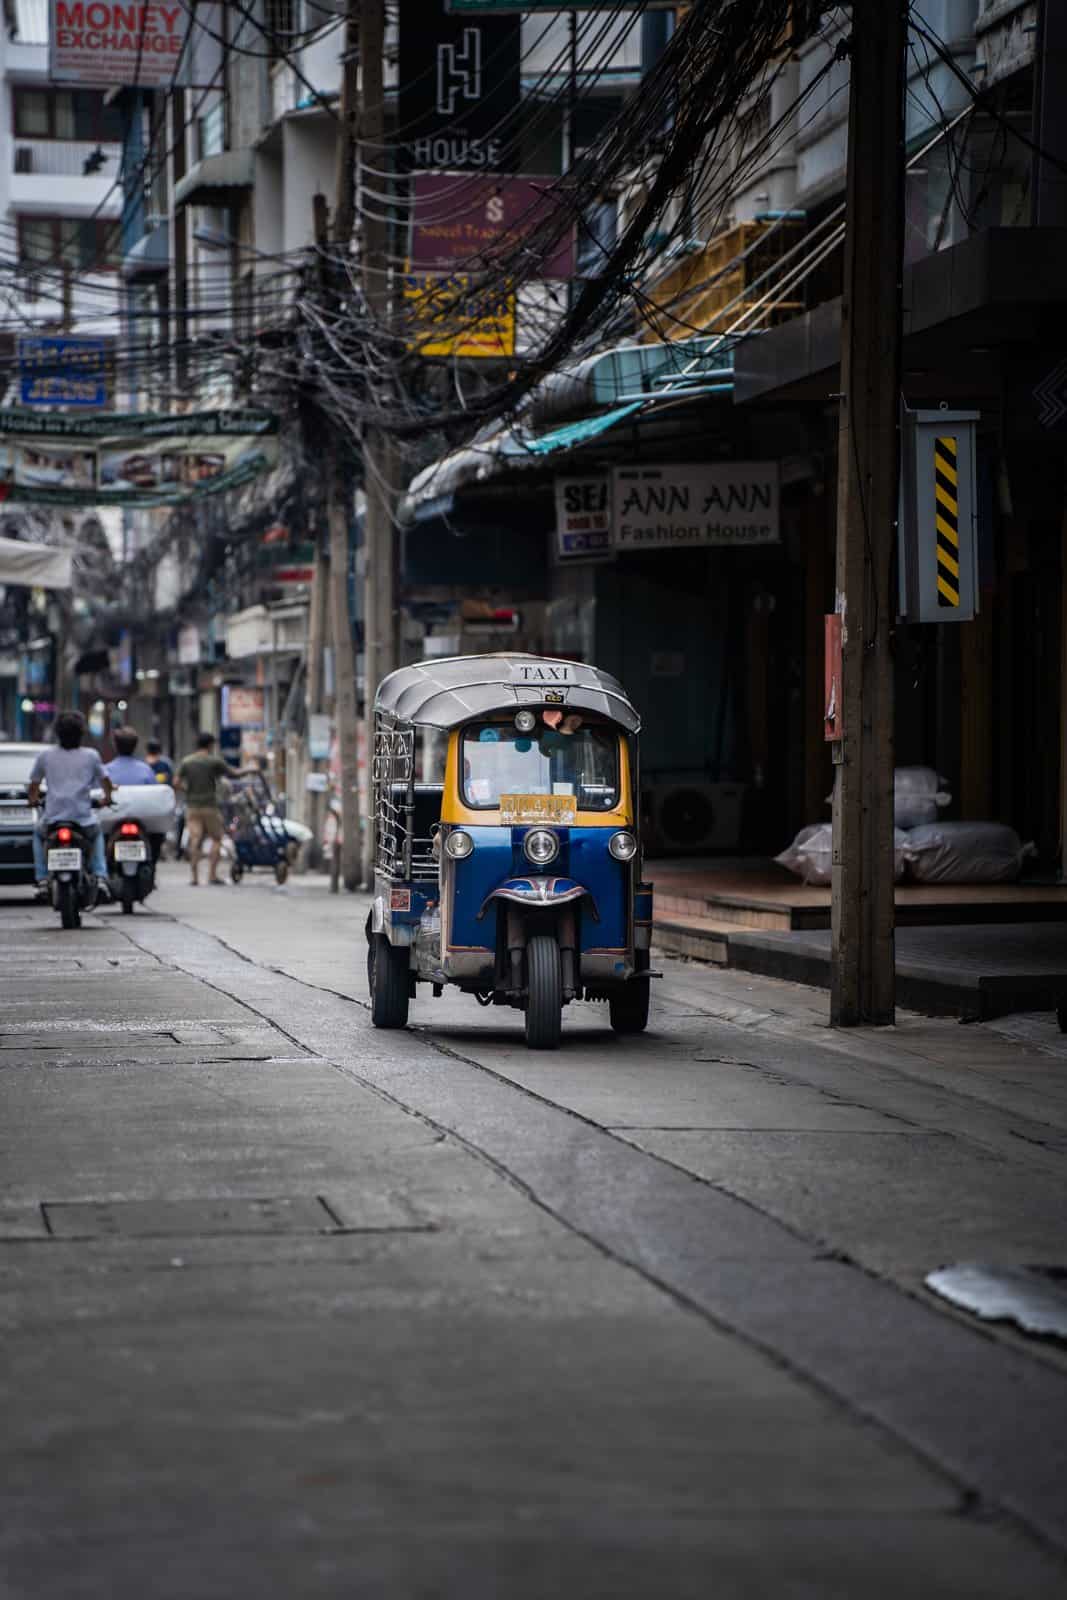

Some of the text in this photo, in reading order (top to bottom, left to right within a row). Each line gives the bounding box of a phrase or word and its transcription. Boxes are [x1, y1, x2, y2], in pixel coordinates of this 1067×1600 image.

[56, 1, 183, 32] MONEY
[56, 31, 183, 54] EXCHANGE
[415, 138, 501, 165] HOUSE
[620, 483, 772, 517] ANN ANN
[619, 523, 771, 541] Fashion House
[520, 667, 568, 680] TAXI
